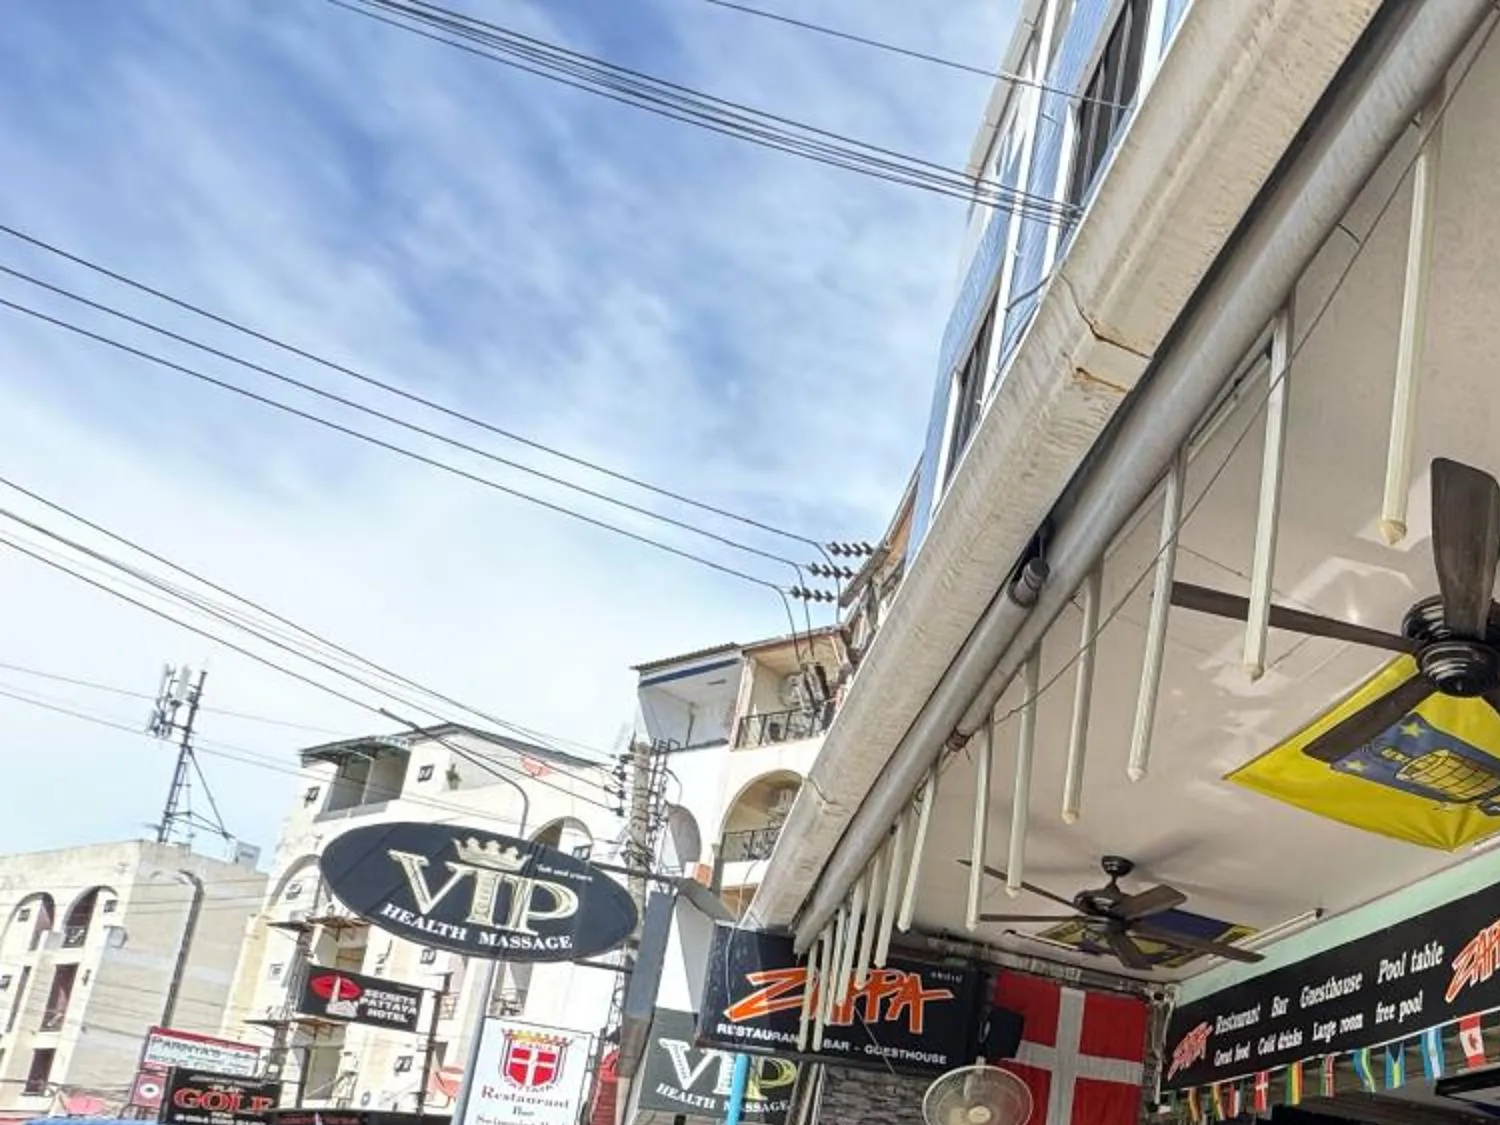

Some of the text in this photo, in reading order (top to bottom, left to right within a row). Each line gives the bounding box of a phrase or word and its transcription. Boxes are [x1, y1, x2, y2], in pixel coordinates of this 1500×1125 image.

[388, 848, 579, 936] VIP
[380, 902, 574, 950] HEALTH MASSAGE
[359, 996, 417, 1016] PATTAYA
[1215, 941, 1445, 1035] Restaurant Bar Guesthouse Pool table
[367, 1007, 409, 1023] HOTEL
[1258, 1035, 1275, 1055] Cold
[1276, 1029, 1303, 1051] drinks
[1312, 1020, 1337, 1044] Large
[1339, 1011, 1364, 1033] room
[1375, 1000, 1395, 1025] free
[1399, 989, 1425, 1023] pool
[716, 1022, 801, 1049] RESTAURAN
[823, 1038, 850, 1051] BAR
[864, 1043, 947, 1066] GUESTHOUSE
[659, 1037, 797, 1101] VIP
[481, 1085, 570, 1109] Restaurant
[656, 1082, 791, 1114] HEALTH MSSAG
